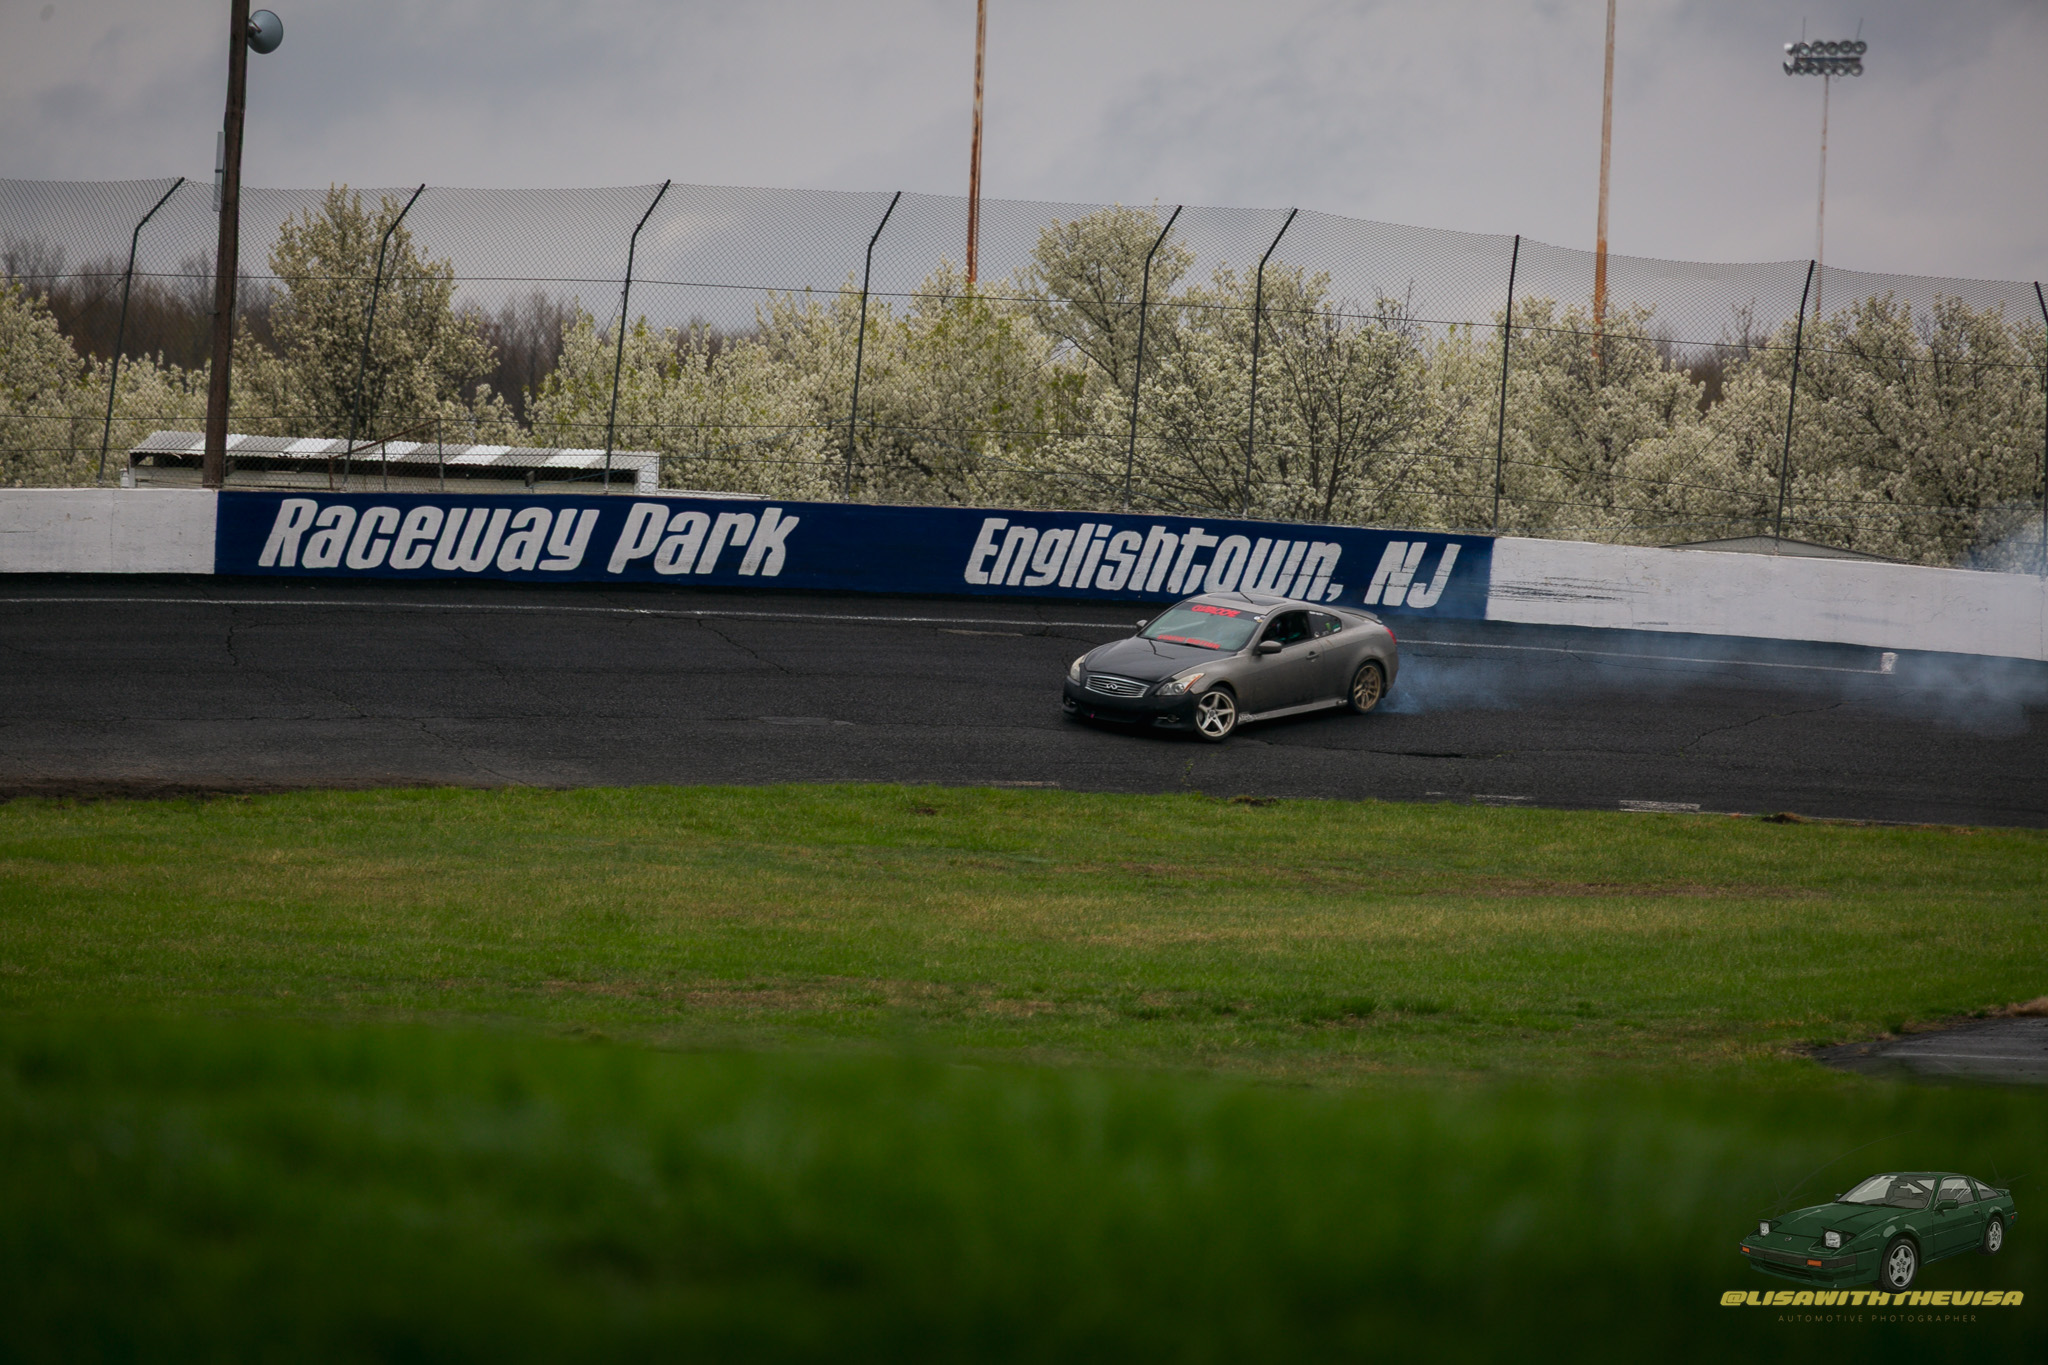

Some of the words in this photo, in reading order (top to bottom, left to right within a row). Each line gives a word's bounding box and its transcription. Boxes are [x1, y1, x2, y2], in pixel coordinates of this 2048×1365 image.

[258, 498, 600, 573] Raceway
[607, 502, 800, 577] Park
[964, 517, 1345, 602] Englishtown,
[1364, 541, 1461, 609] NJ
